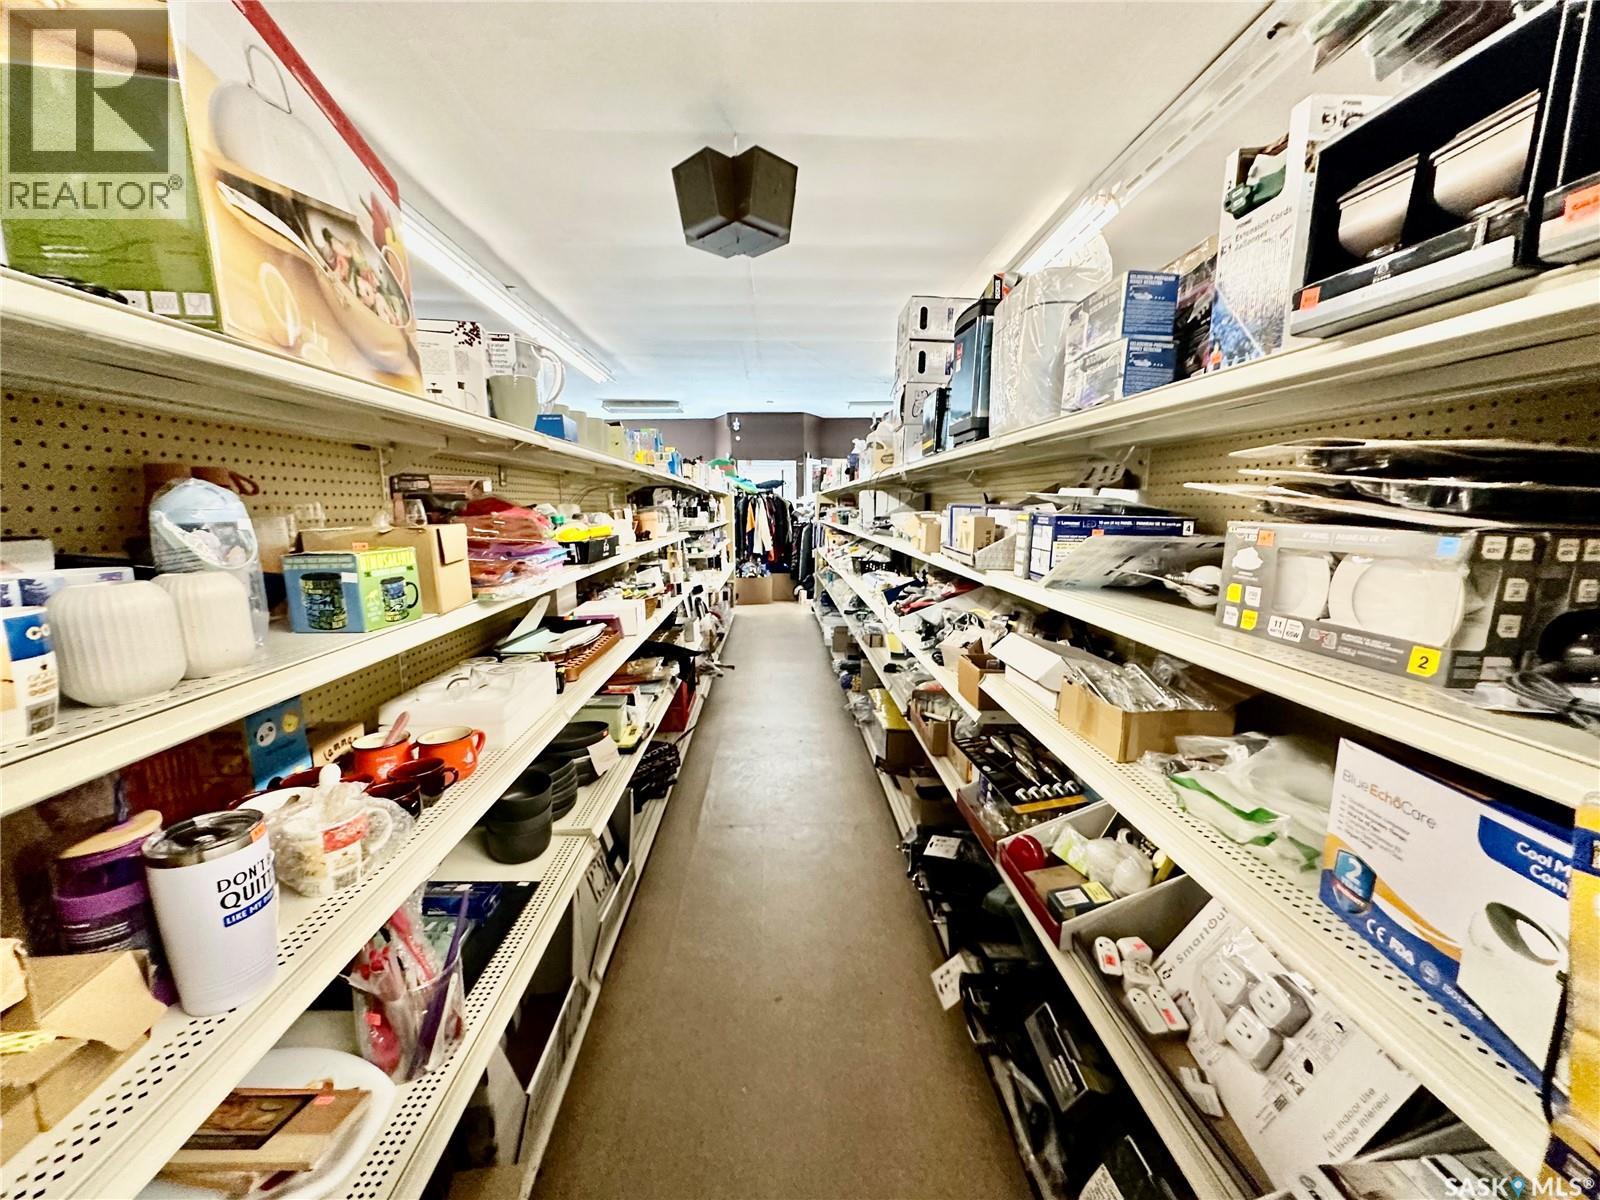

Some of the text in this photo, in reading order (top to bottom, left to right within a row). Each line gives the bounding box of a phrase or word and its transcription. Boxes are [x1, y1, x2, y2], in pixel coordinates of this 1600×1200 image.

[1235, 206, 1293, 241] Extension Cords
[1082, 520, 1097, 529] LED
[1185, 524, 1192, 532] 4
[1417, 655, 1429, 670] 2
[1515, 841, 1550, 867] Cool
[216, 859, 266, 893] DON'T
[1347, 857, 1363, 886] 2
[225, 900, 263, 926] LIKE MY
